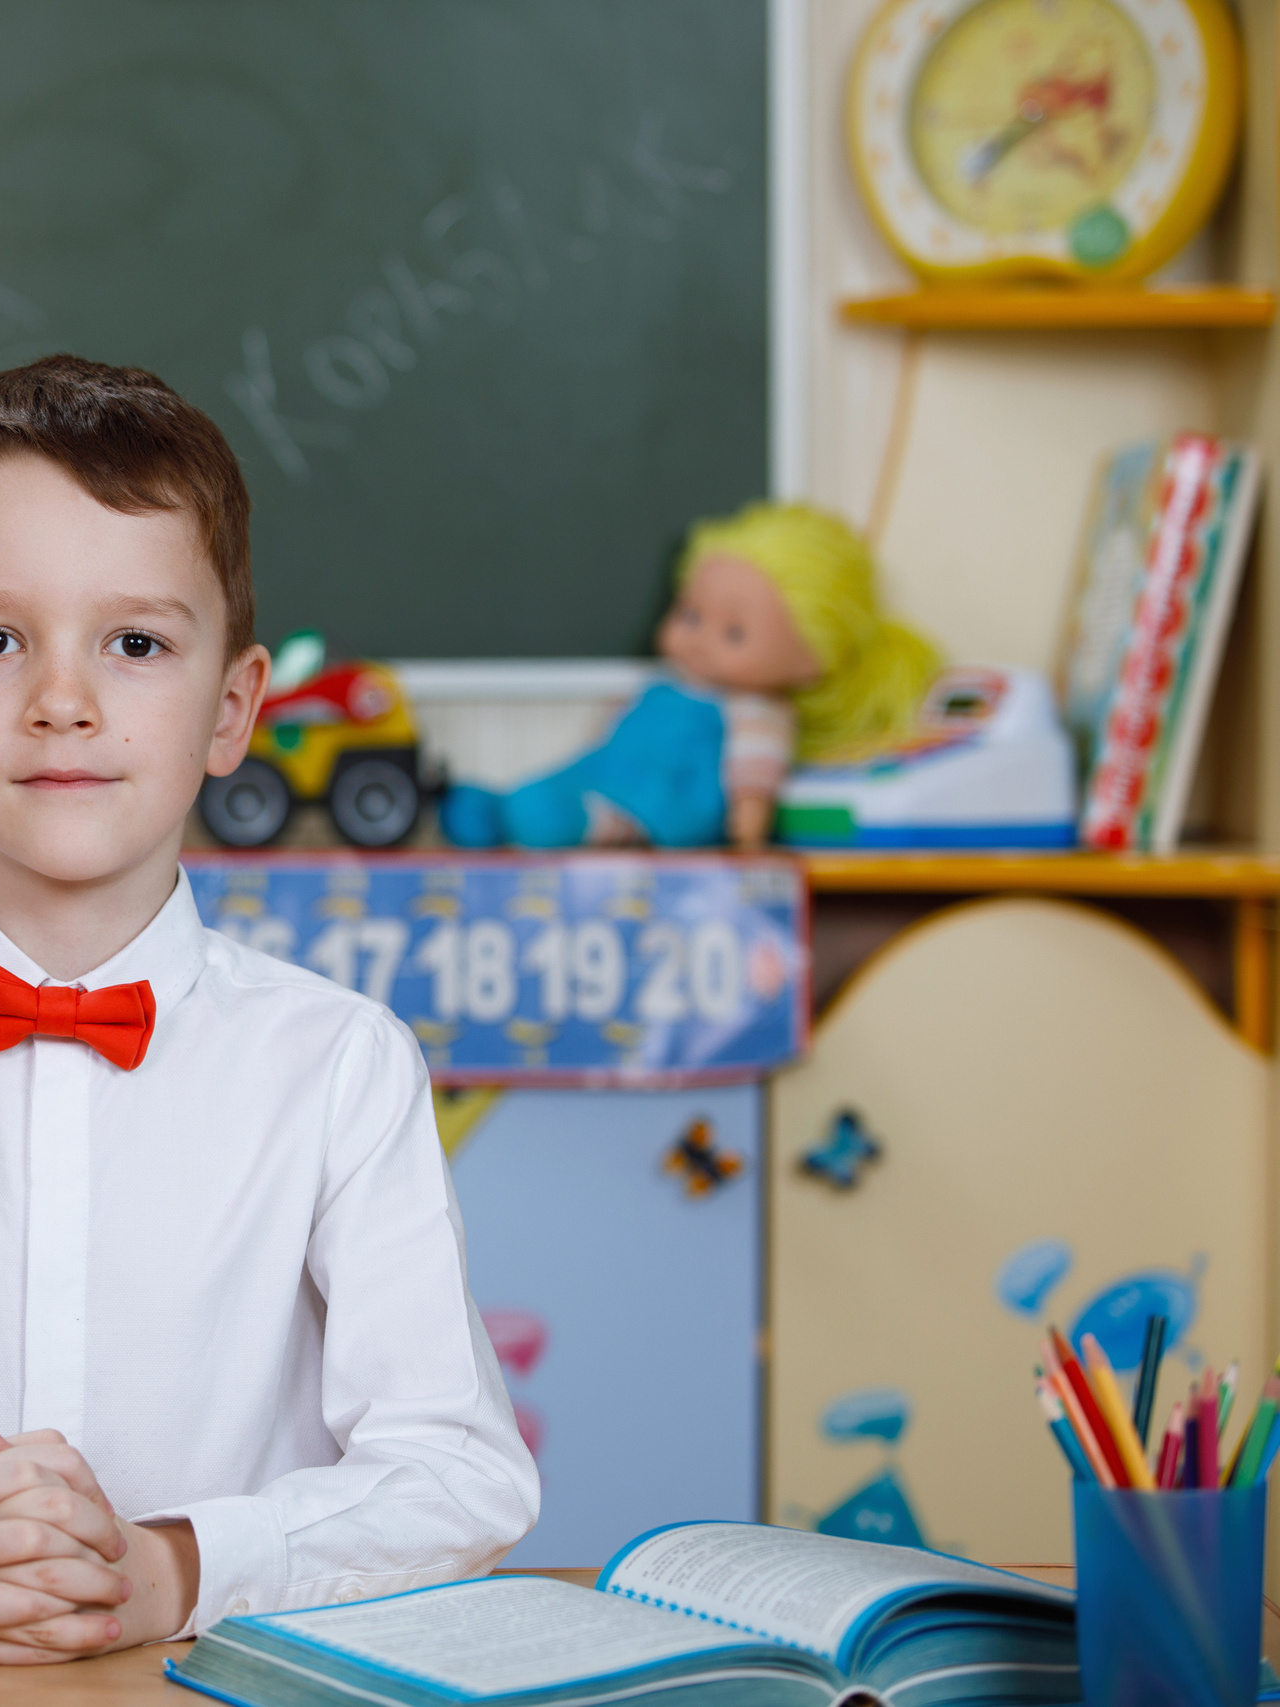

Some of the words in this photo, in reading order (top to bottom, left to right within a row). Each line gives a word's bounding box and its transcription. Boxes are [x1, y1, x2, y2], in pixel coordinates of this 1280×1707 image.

[420, 918, 517, 1022] 18
[526, 918, 624, 1022] 19
[634, 918, 744, 1022] 20
